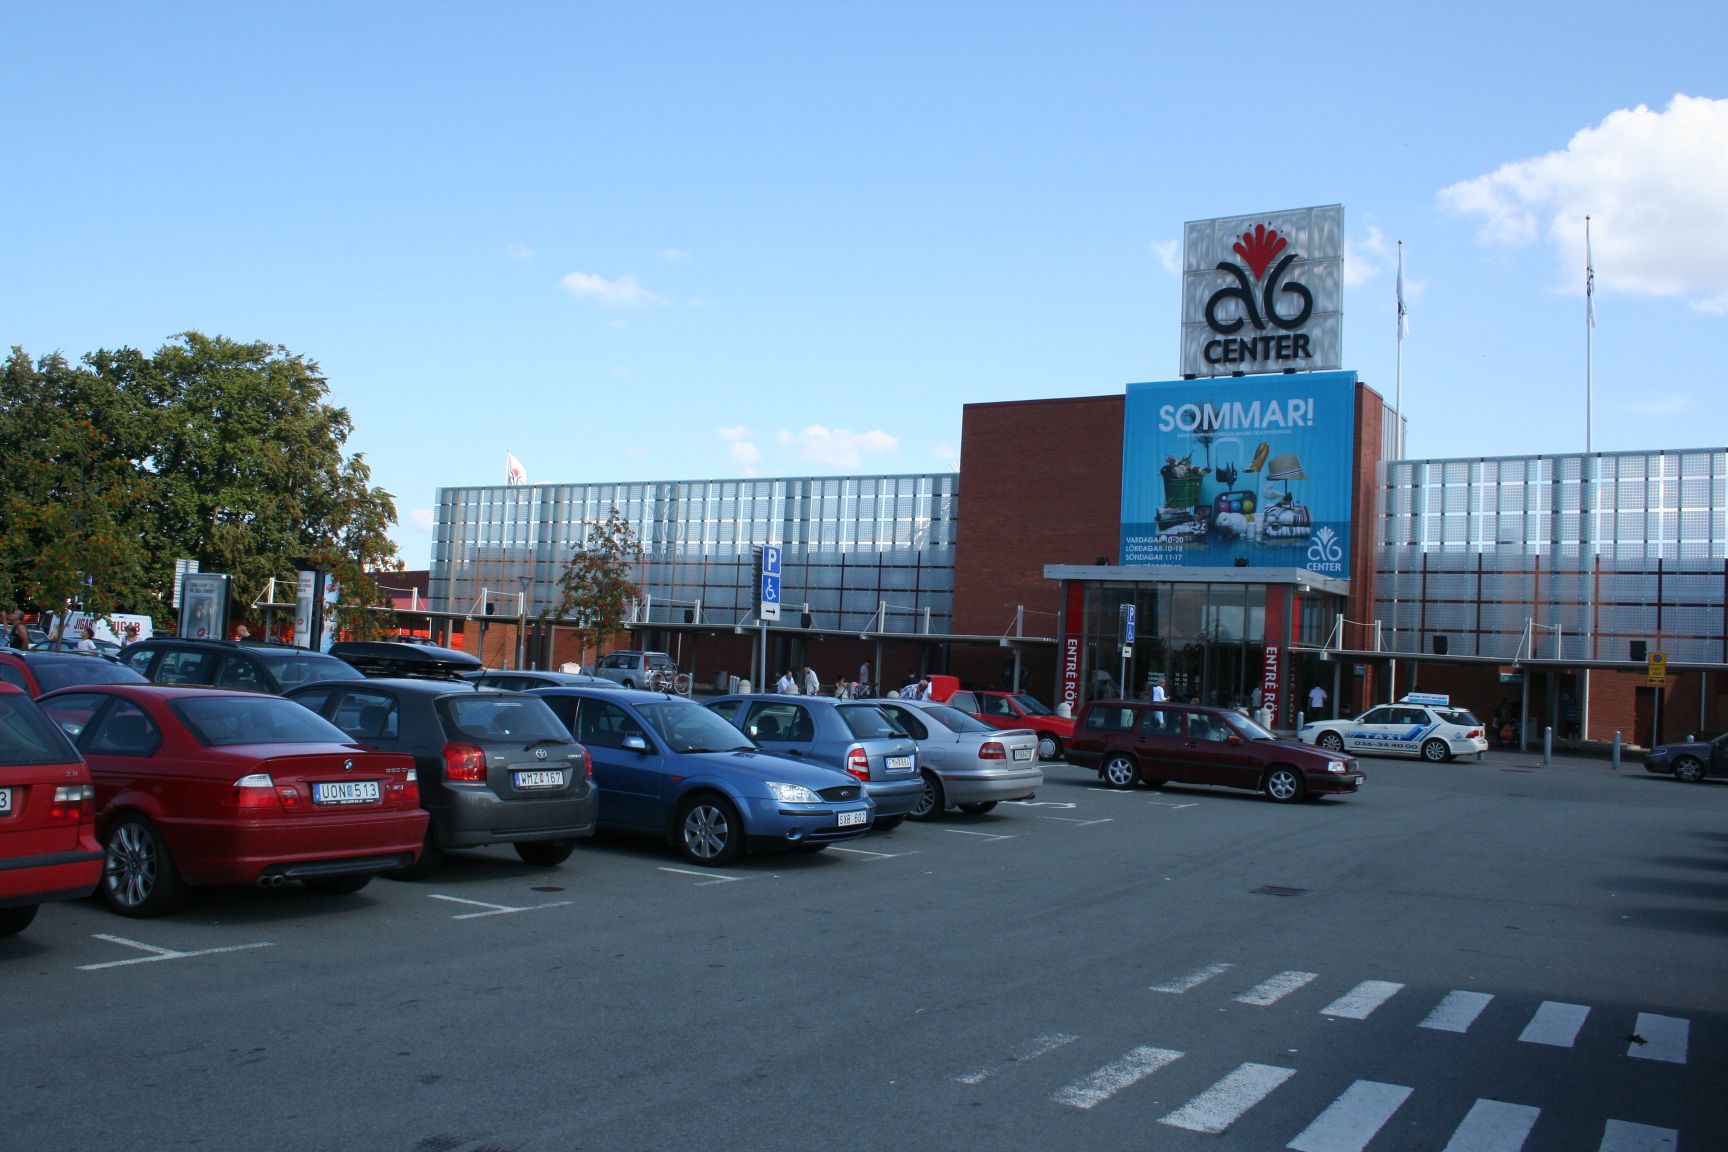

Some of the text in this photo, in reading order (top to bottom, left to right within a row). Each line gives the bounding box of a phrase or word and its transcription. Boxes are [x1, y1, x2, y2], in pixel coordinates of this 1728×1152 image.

[1204, 334, 1312, 365] CENTER
[1158, 398, 1314, 432] SOMMAR!
[1125, 544, 1163, 552] LÖRDAGAR
[1126, 536, 1184, 544] VARDAGAR 10-20
[768, 548, 777, 572] P
[1125, 552, 1163, 561] SÖNDAGAR
[1306, 562, 1342, 572] CENTER
[1065, 638, 1079, 679] ENTRÉ
[1264, 646, 1279, 689] ENTRÉ
[520, 772, 561, 785] WMZ 167
[322, 783, 377, 799] UON 513
